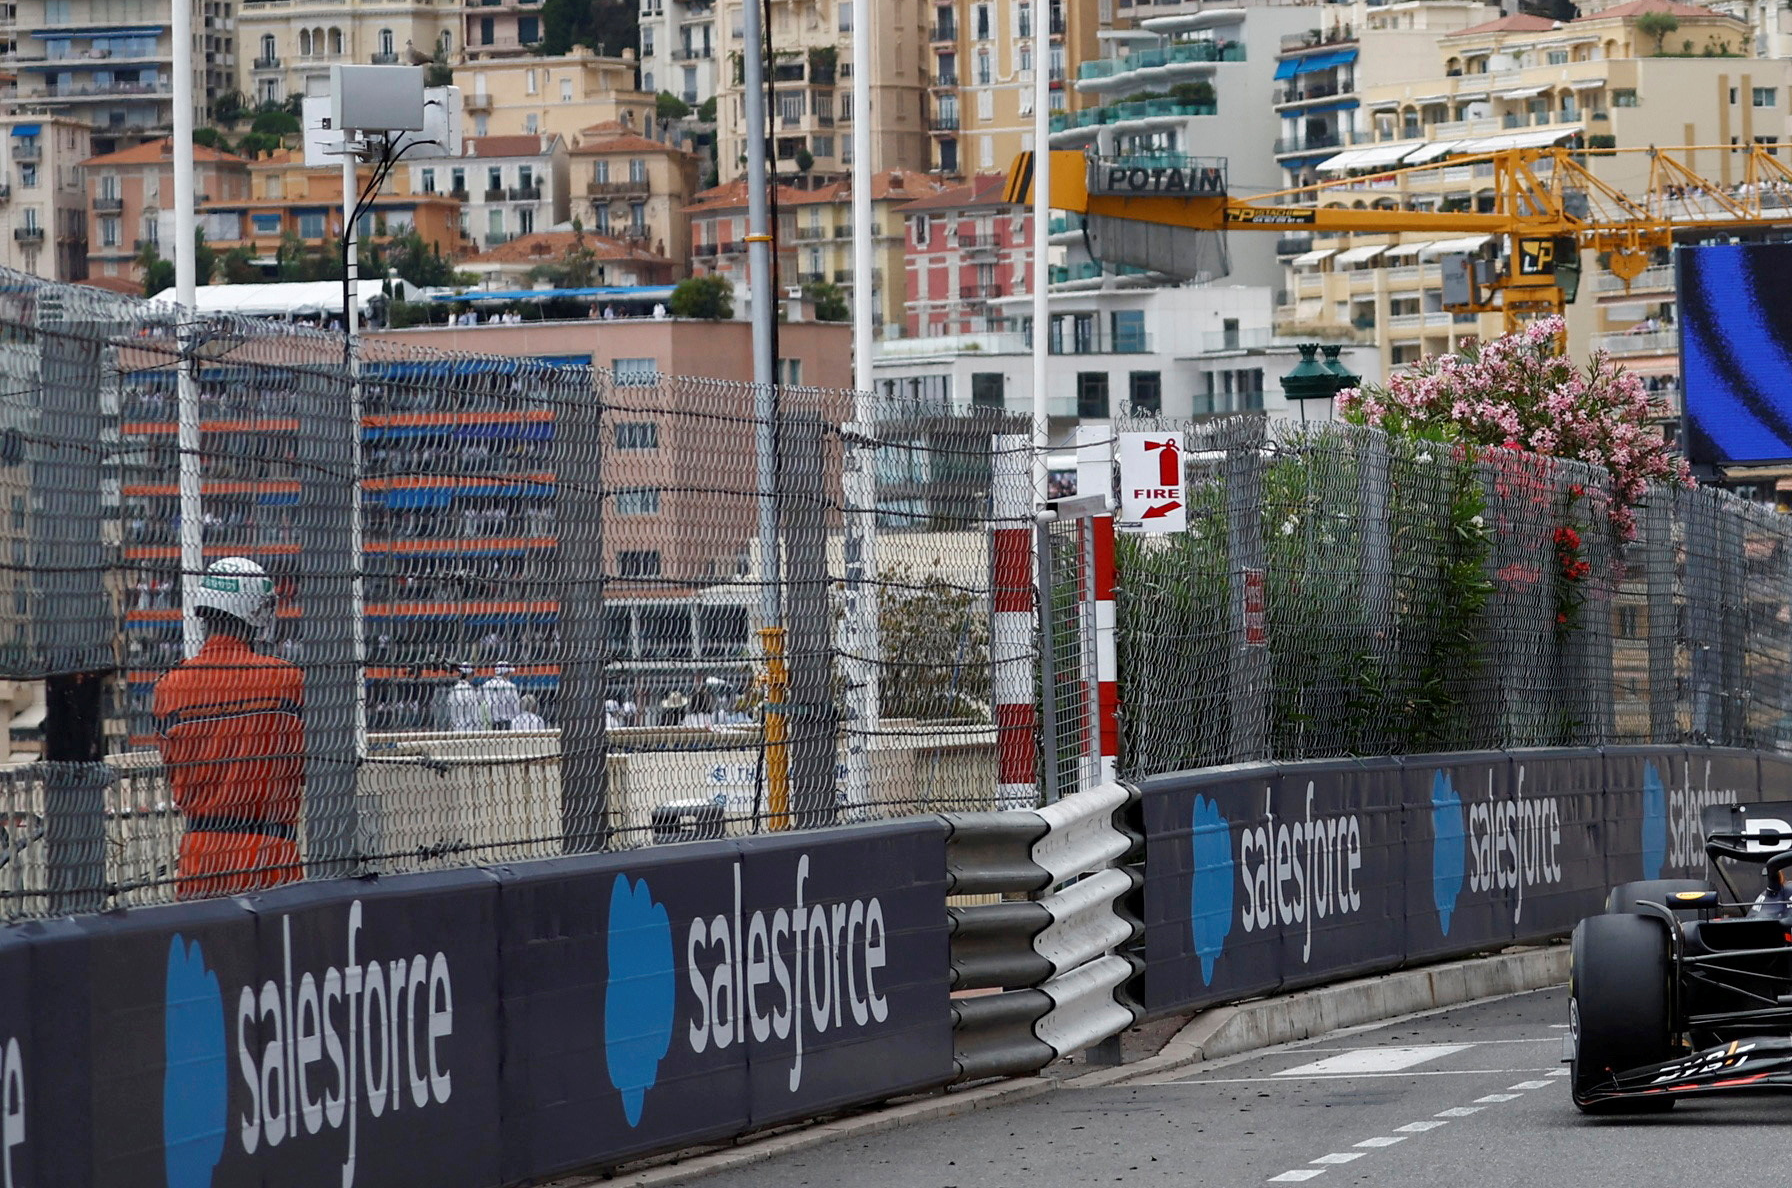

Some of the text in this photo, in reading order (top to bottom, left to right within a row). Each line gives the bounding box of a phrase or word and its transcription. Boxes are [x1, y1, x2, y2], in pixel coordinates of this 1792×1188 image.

[1108, 167, 1224, 192] POTAIN
[1134, 489, 1180, 499] FIRE
[1241, 780, 1361, 964] salesforce
[1469, 765, 1561, 925] salesforce
[238, 900, 453, 1188] salesforce
[688, 854, 889, 1093] salesforce
